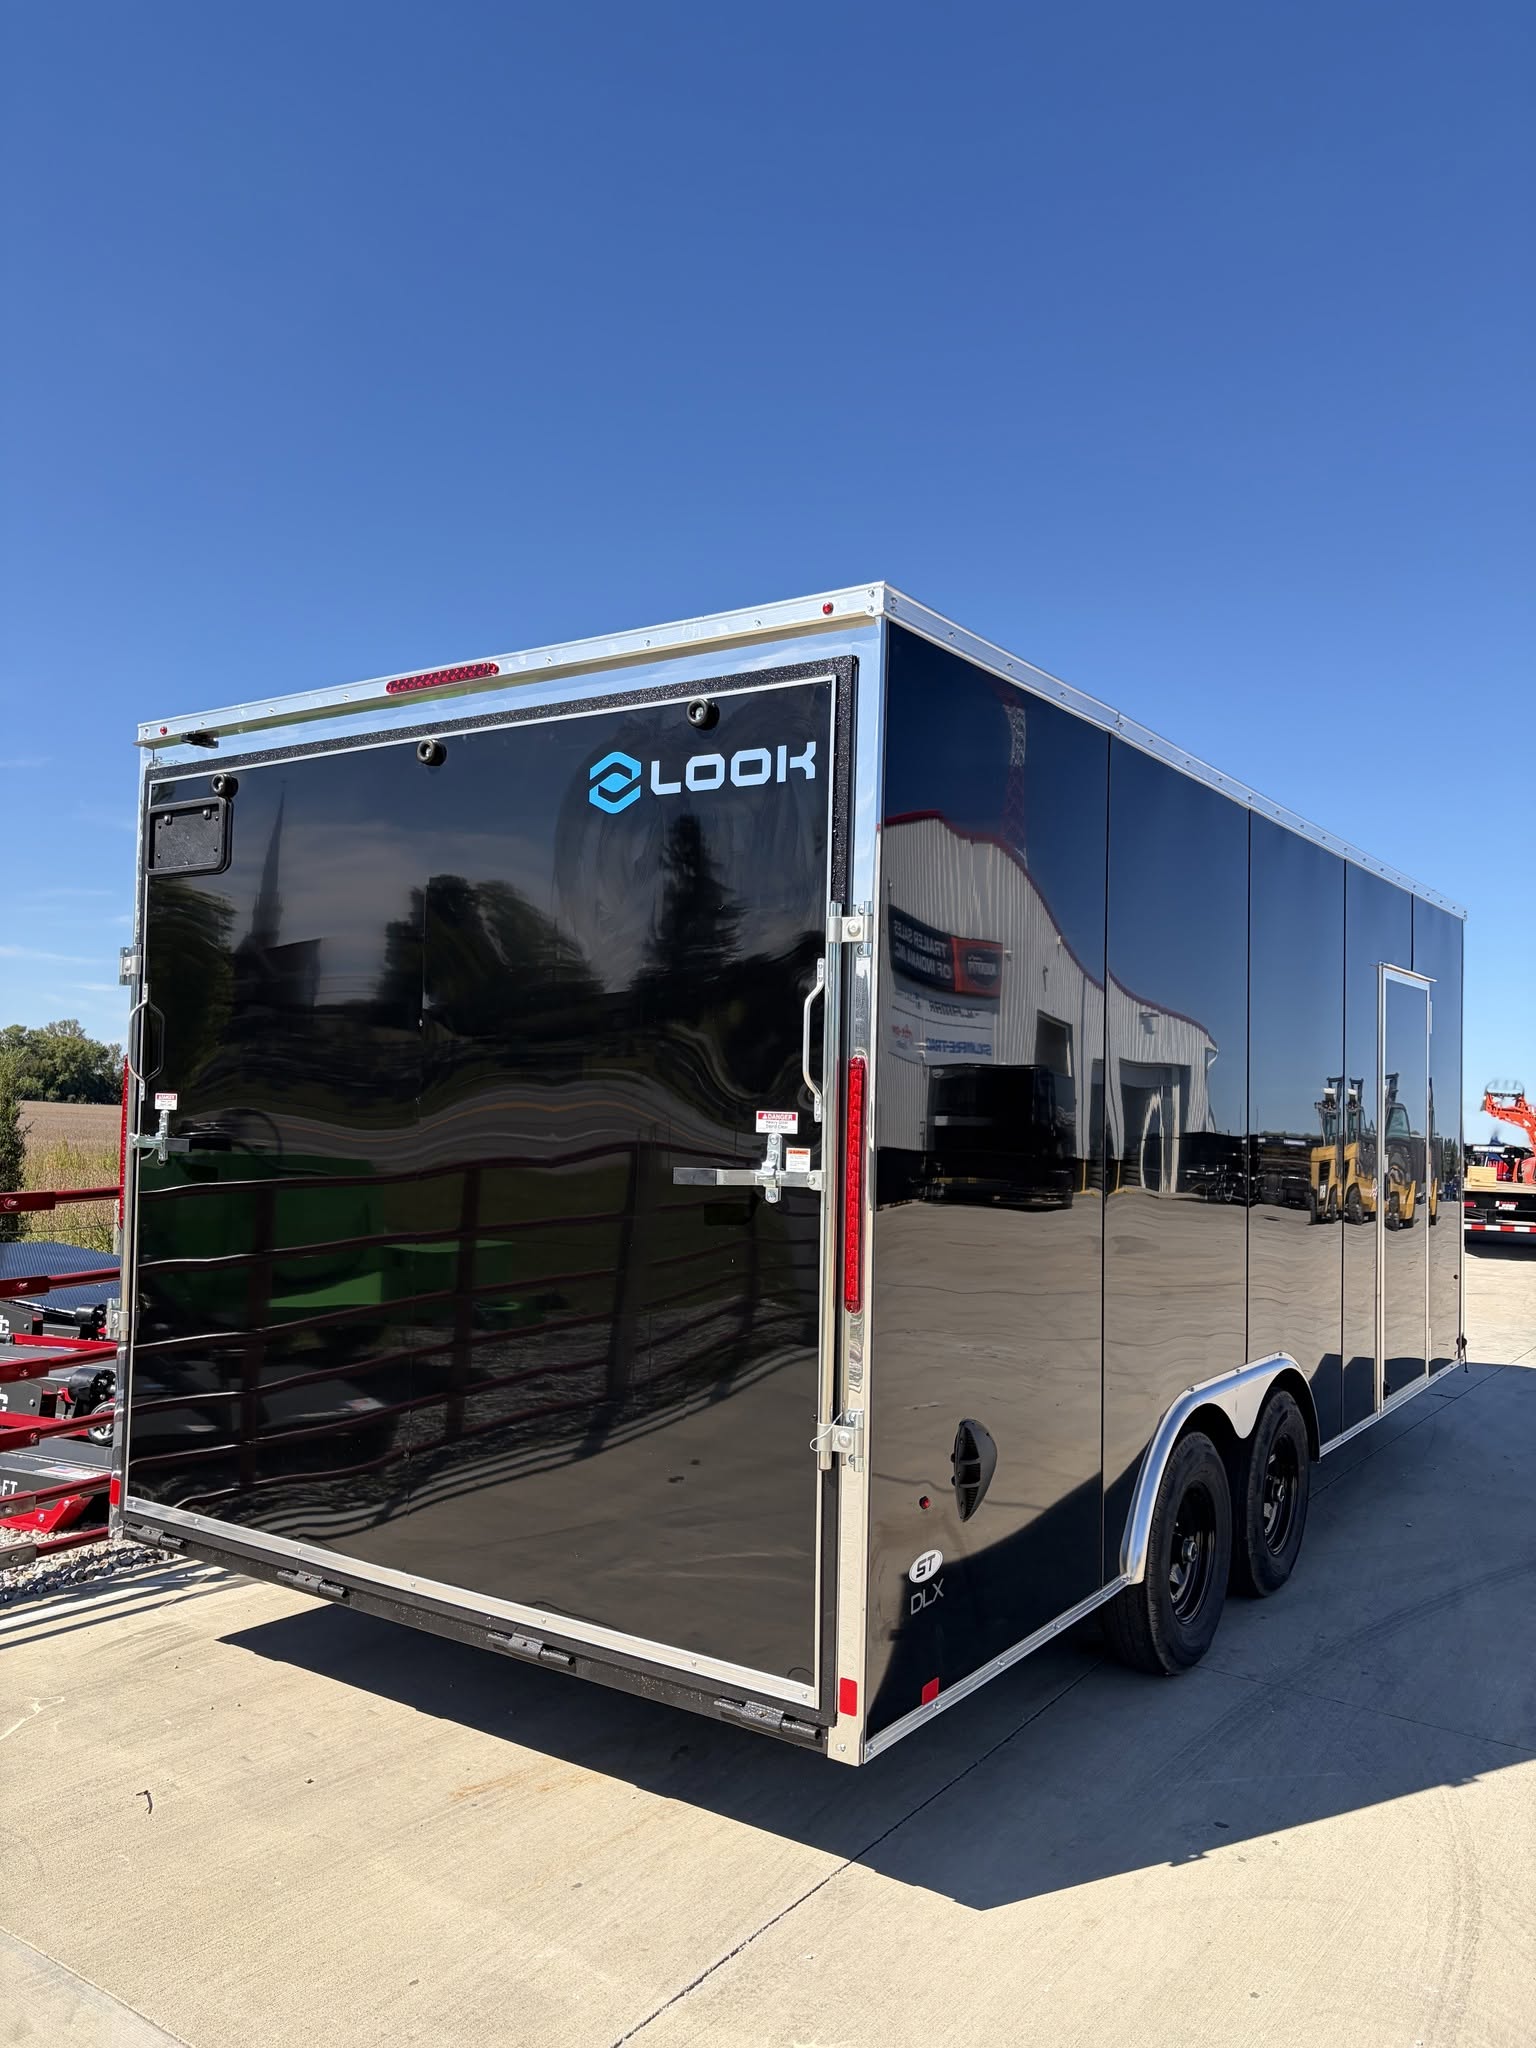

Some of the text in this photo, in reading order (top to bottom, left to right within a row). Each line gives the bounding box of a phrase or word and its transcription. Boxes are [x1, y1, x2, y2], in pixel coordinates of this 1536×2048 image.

[650, 741, 817, 796] LOOK
[916, 1554, 935, 1578] ST
[910, 1578, 944, 1616] DLX
